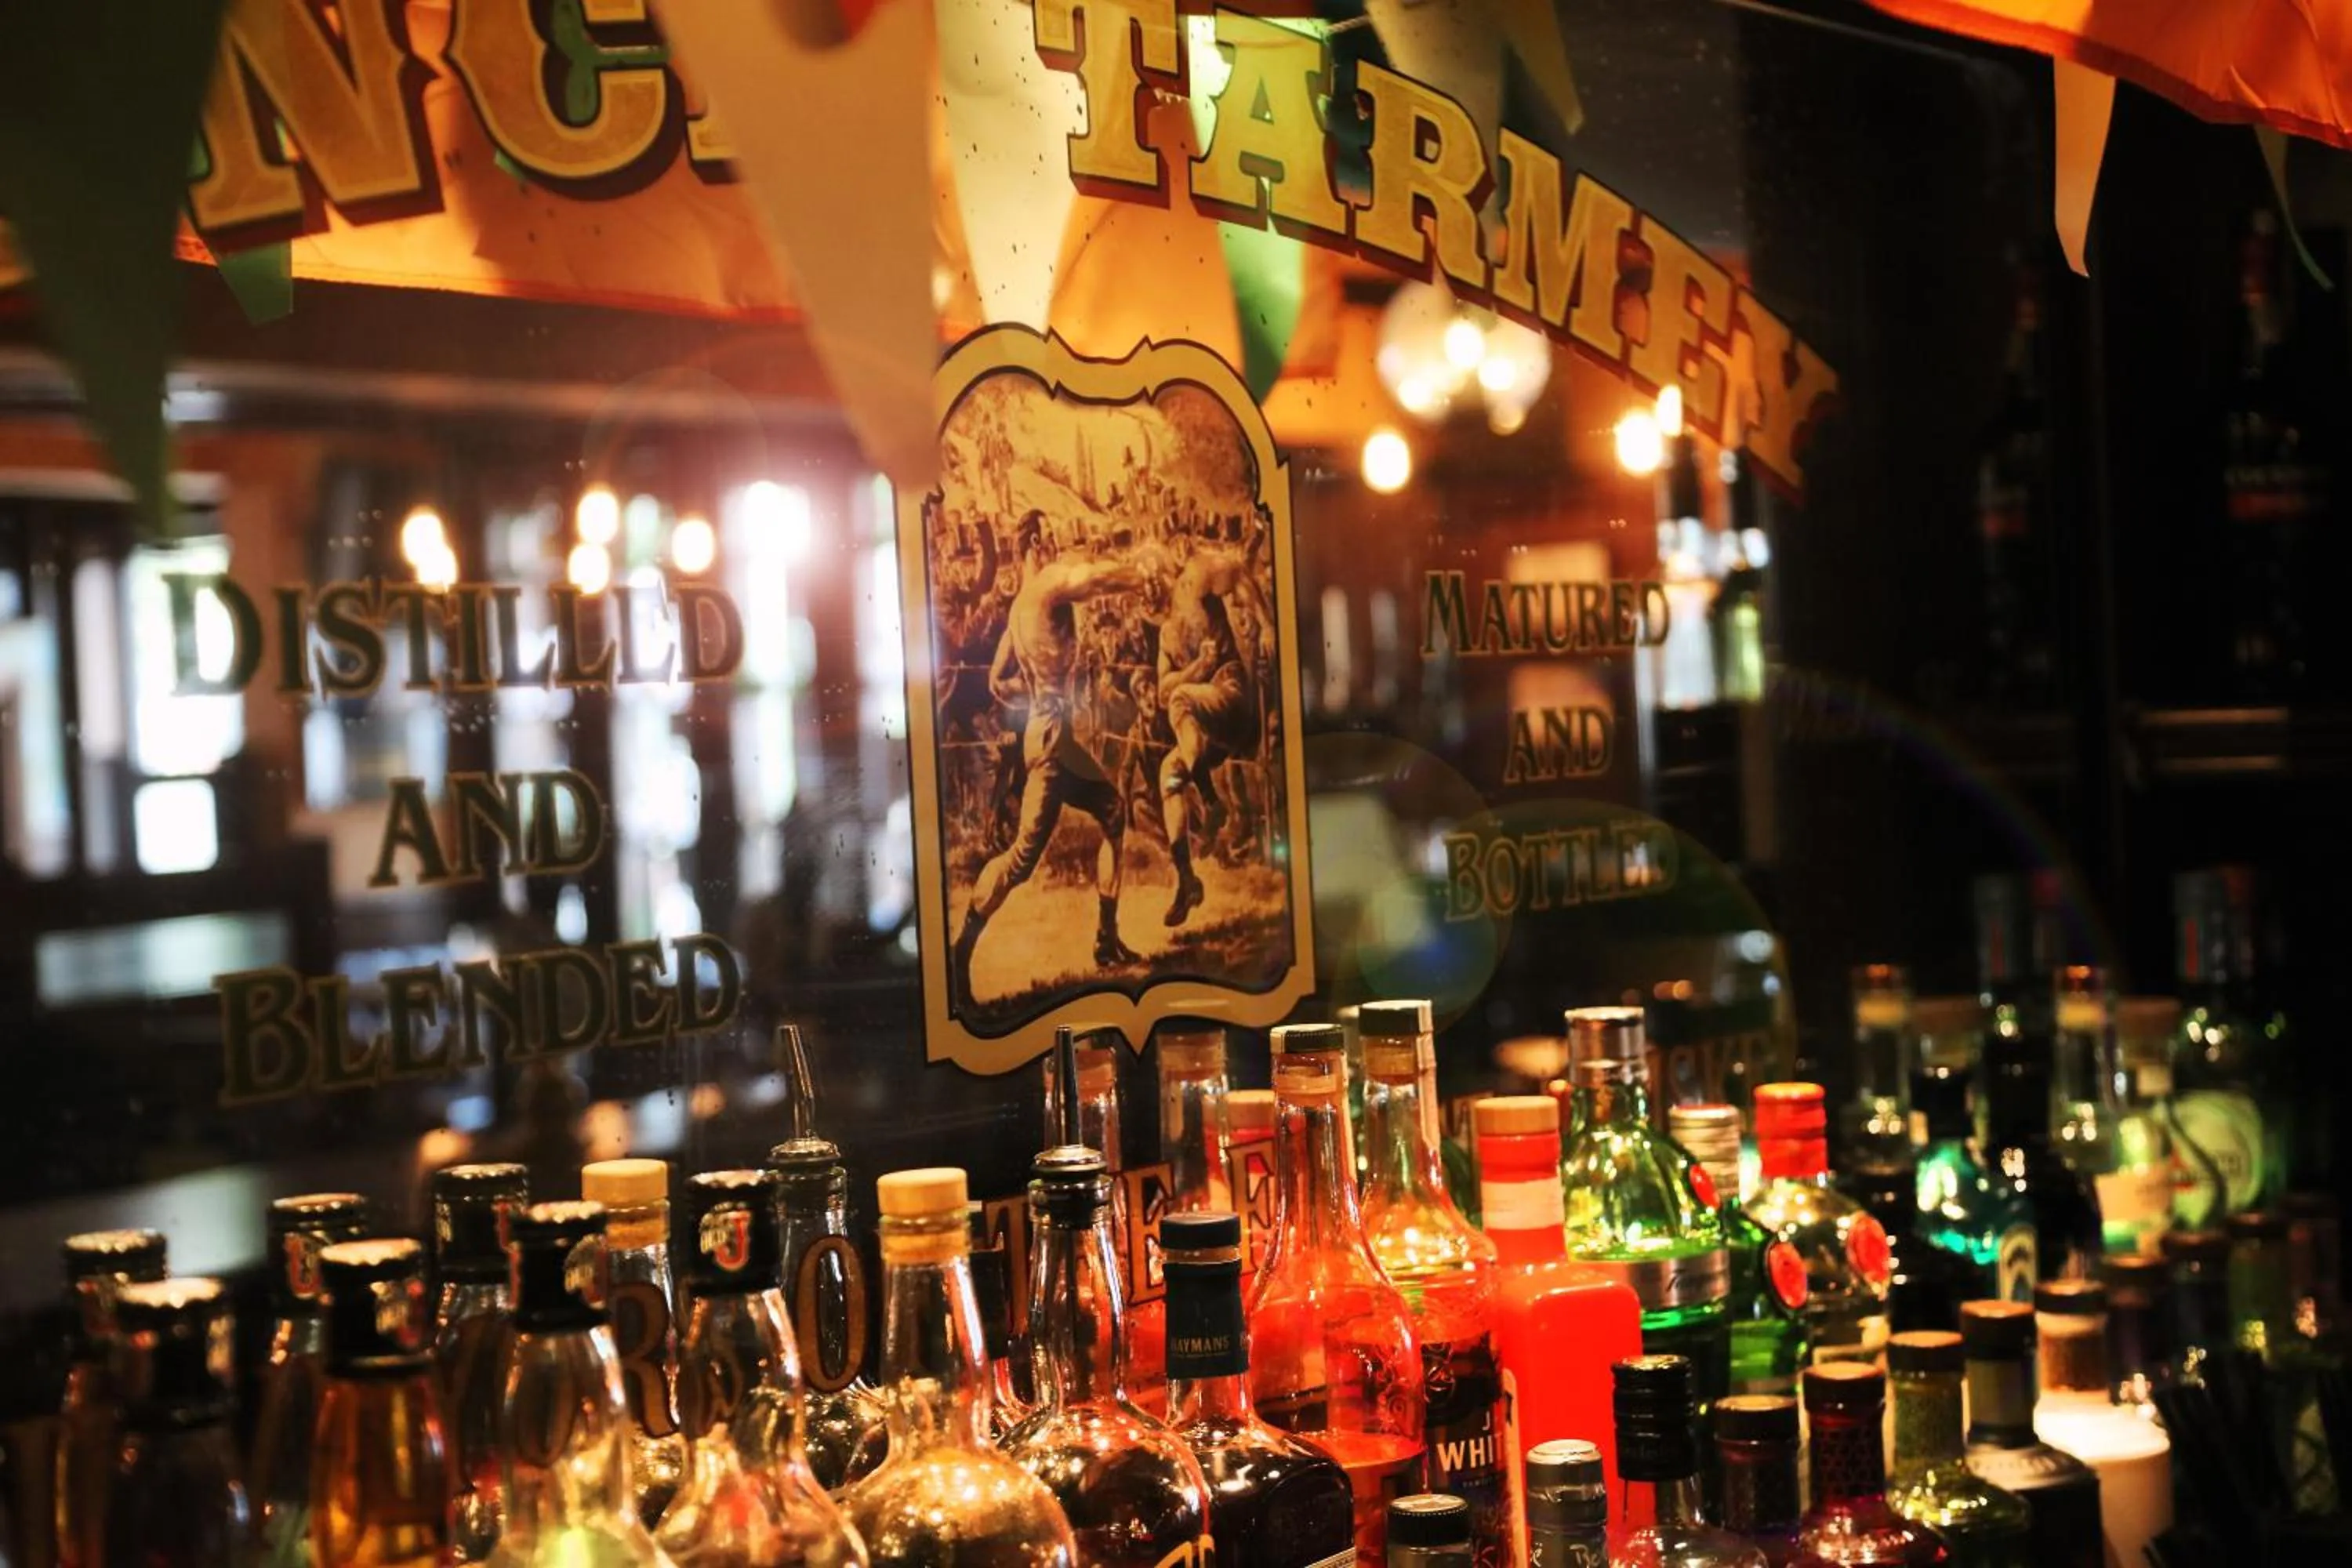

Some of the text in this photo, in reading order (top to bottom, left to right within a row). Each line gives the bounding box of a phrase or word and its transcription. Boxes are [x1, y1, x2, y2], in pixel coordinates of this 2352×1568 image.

[1033, 0, 1839, 494] TARMEY
[161, 572, 745, 699] DISTILLED
[1421, 569, 1673, 657] MATURED
[1503, 706, 1616, 783] AND
[366, 768, 605, 888] AND
[212, 932, 745, 1107] BLENDED
